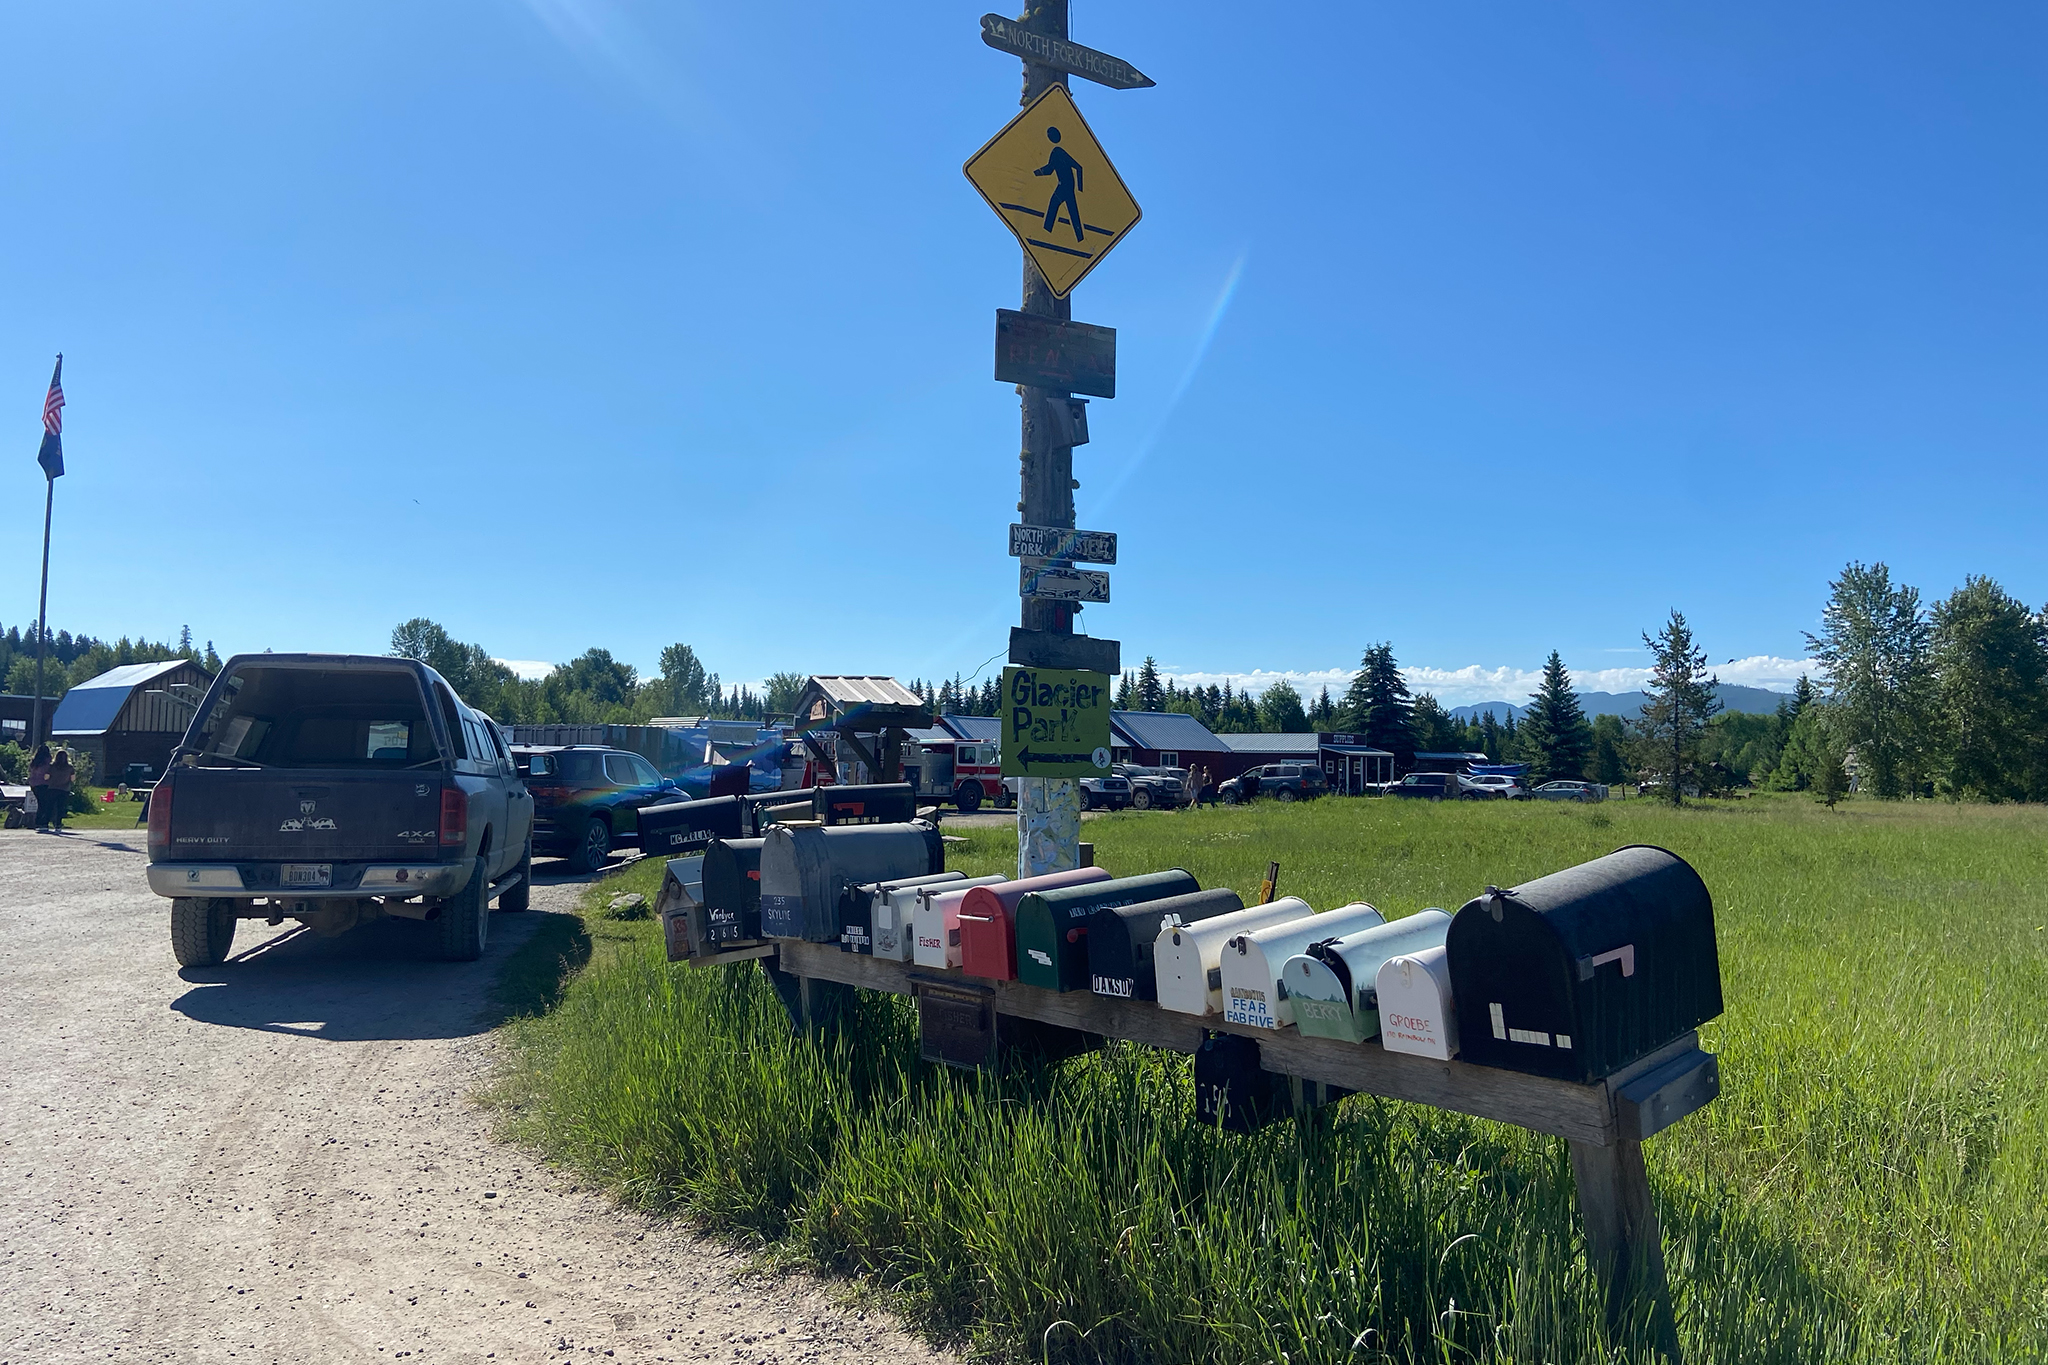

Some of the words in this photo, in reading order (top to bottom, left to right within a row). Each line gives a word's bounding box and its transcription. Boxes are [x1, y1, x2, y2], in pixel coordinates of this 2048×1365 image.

[1008, 26, 1050, 57] NORTH
[1052, 40, 1084, 68] FORK
[1086, 52, 1131, 84] HOSTEL
[1014, 527, 1043, 543] NORTH
[1014, 541, 1044, 556] FORK
[1011, 670, 1105, 709] Glacier
[1012, 706, 1081, 743] Park
[1333, 734, 1355, 744] SUPPLIES
[918, 936, 942, 949] FISHER
[1232, 998, 1267, 1015] FEAR
[1303, 1001, 1343, 1022] BERRY
[1227, 1010, 1247, 1024] FAB
[1248, 1014, 1274, 1029] FIVE
